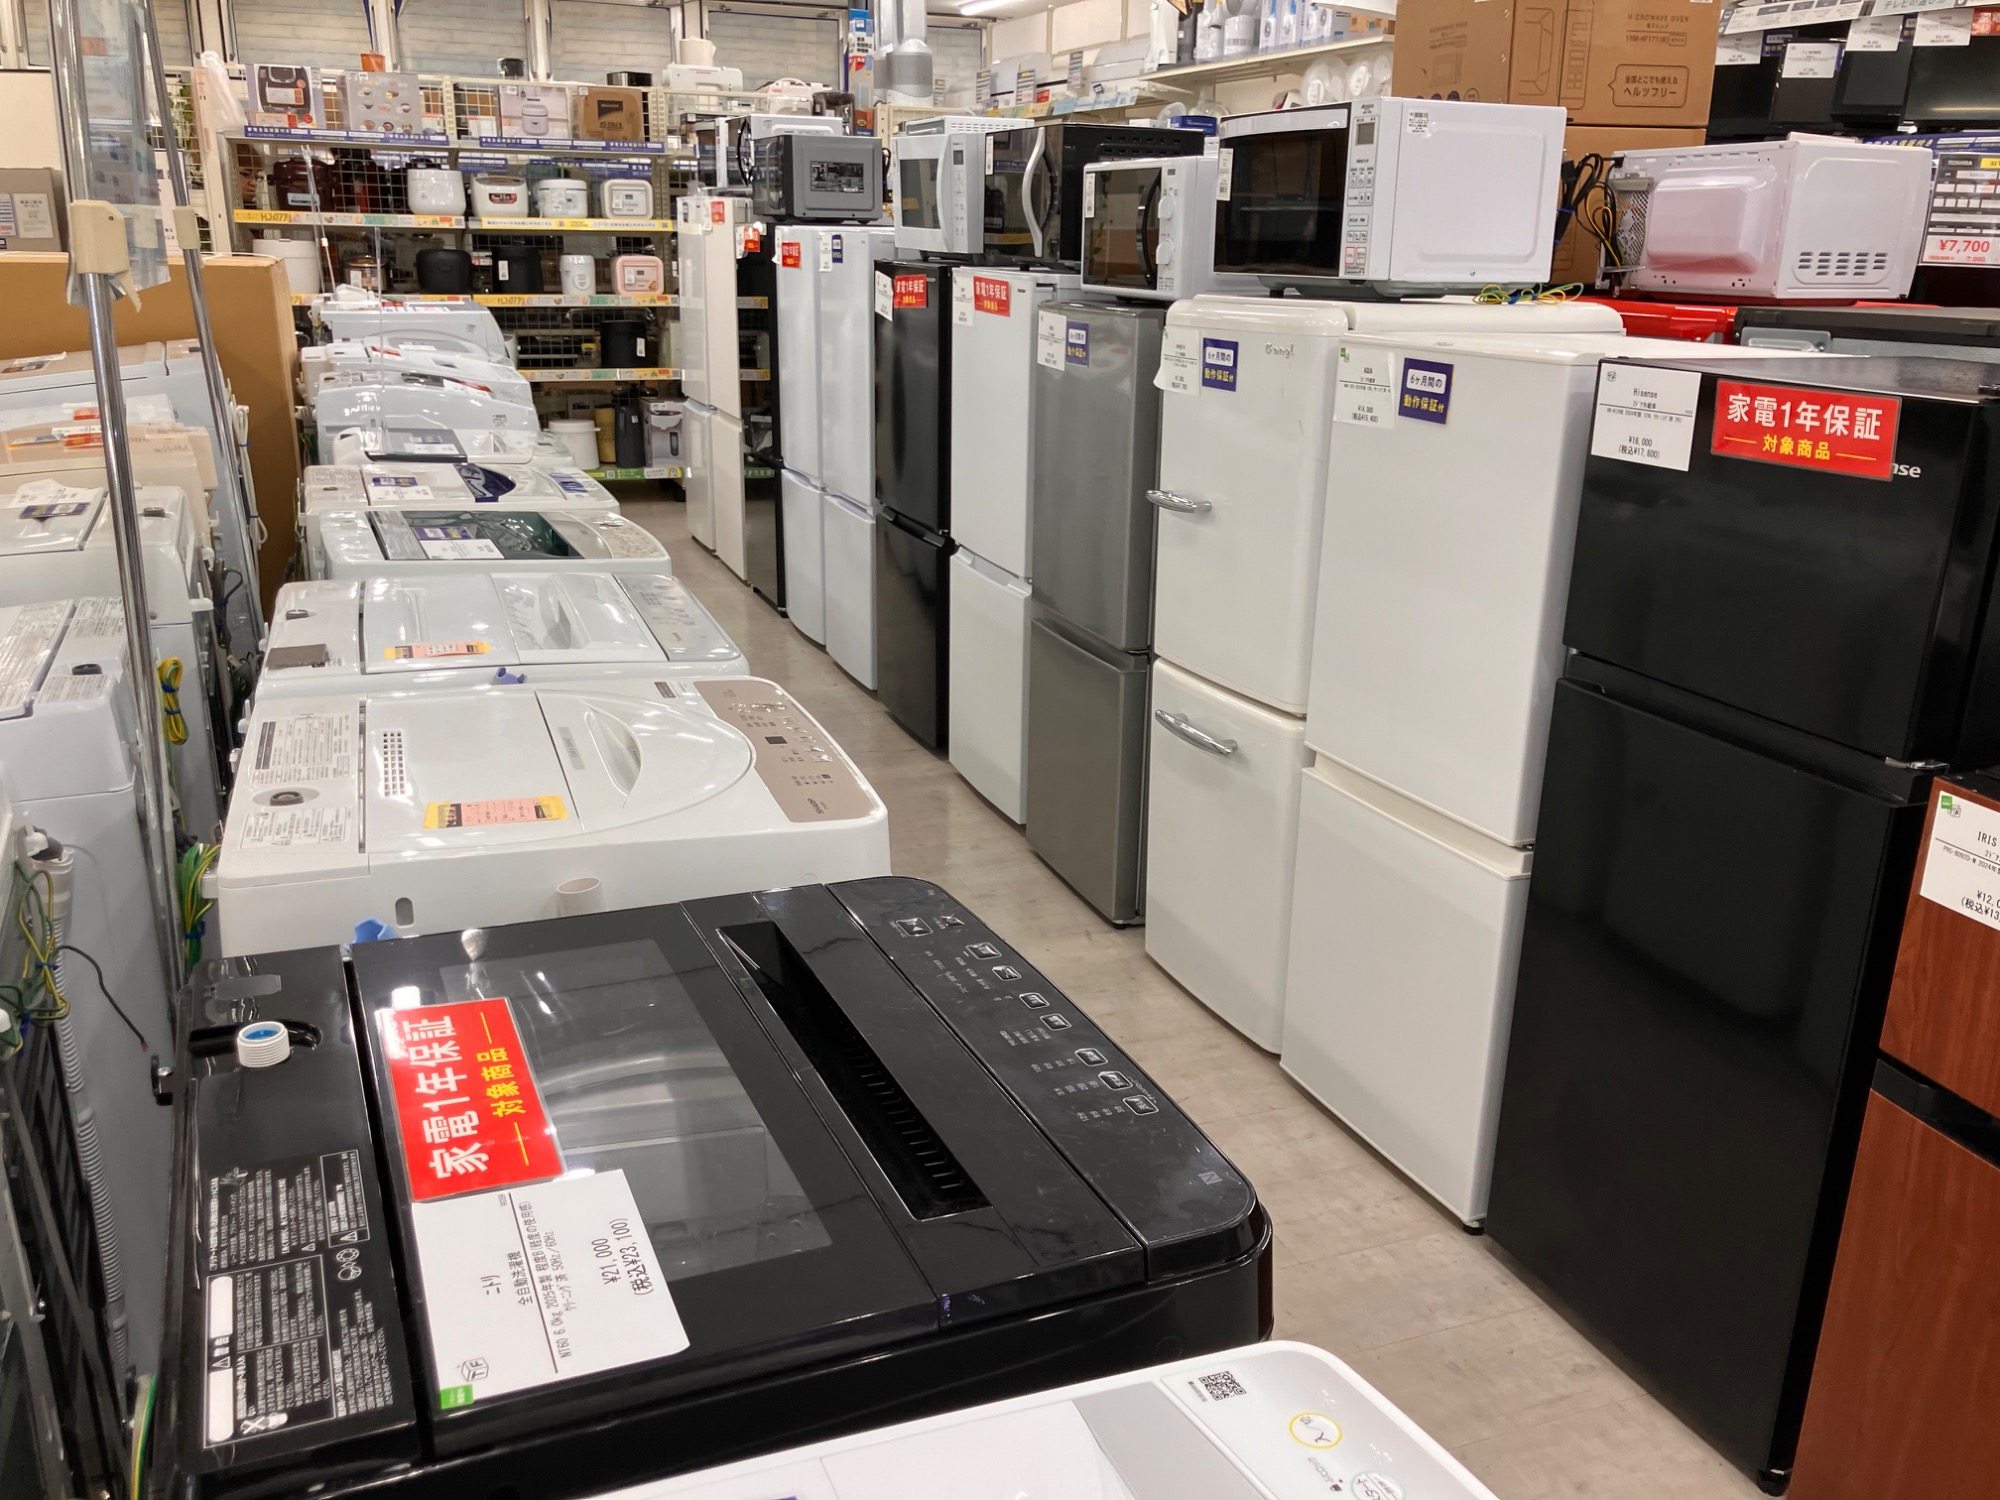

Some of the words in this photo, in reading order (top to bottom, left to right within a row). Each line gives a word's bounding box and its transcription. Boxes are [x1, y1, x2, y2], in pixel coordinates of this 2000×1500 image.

[1624, 75, 1678, 84] 全国どこでも使える
[1624, 87, 1677, 97] ヘルツフリー
[1939, 239, 1990, 254] ¥7,700
[1410, 374, 1443, 389] 6ヶ月間の
[1403, 394, 1445, 414] 動作保証付
[1633, 388, 1658, 399] Hisense
[1727, 393, 1884, 441] 家電1年保証
[1628, 435, 1653, 447] ¥16,000
[1762, 433, 1831, 461] 対象商品
[1977, 831, 1998, 847] IRIS
[477, 1047, 527, 1118] 対象商品
[402, 1015, 490, 1180] 家電1年保証
[591, 1238, 619, 1285] ¥21,000
[611, 1217, 646, 1297] (税込¥23,100)
[482, 1274, 502, 1296] ニトリ
[506, 1250, 534, 1306] 全自動洗濯機
[540, 1272, 561, 1310] 2025年製
[559, 1336, 573, 1359] NT60
